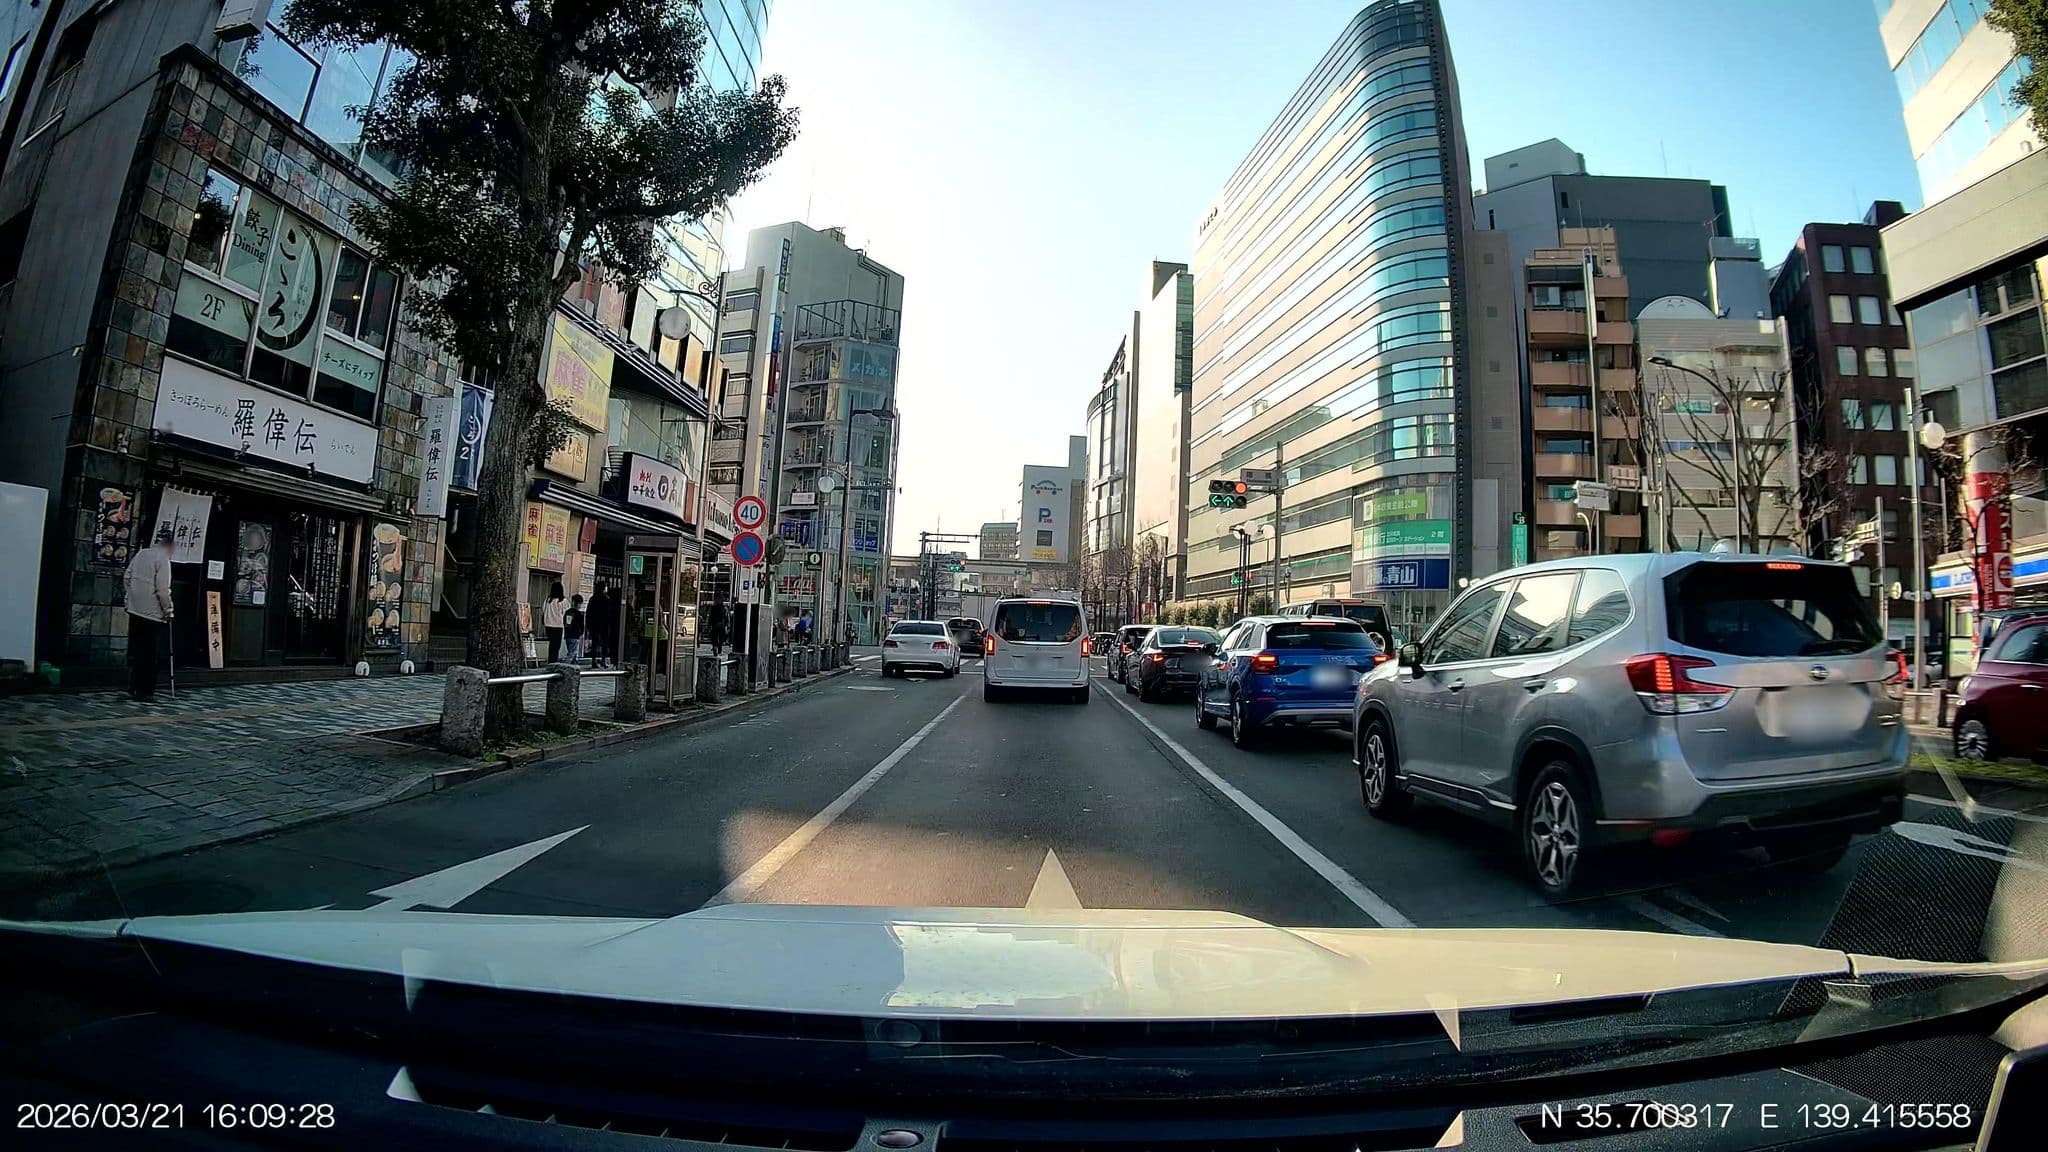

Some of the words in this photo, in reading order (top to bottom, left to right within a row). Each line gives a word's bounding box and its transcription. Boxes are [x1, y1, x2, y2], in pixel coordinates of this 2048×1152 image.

[243, 208, 270, 247] 餃子
[231, 232, 266, 264] Dining
[200, 293, 226, 321] 2F
[231, 398, 317, 456] 羅偉伝
[424, 427, 443, 482] 羅偉伝
[740, 505, 760, 521] 40
[1039, 507, 1052, 523] P
